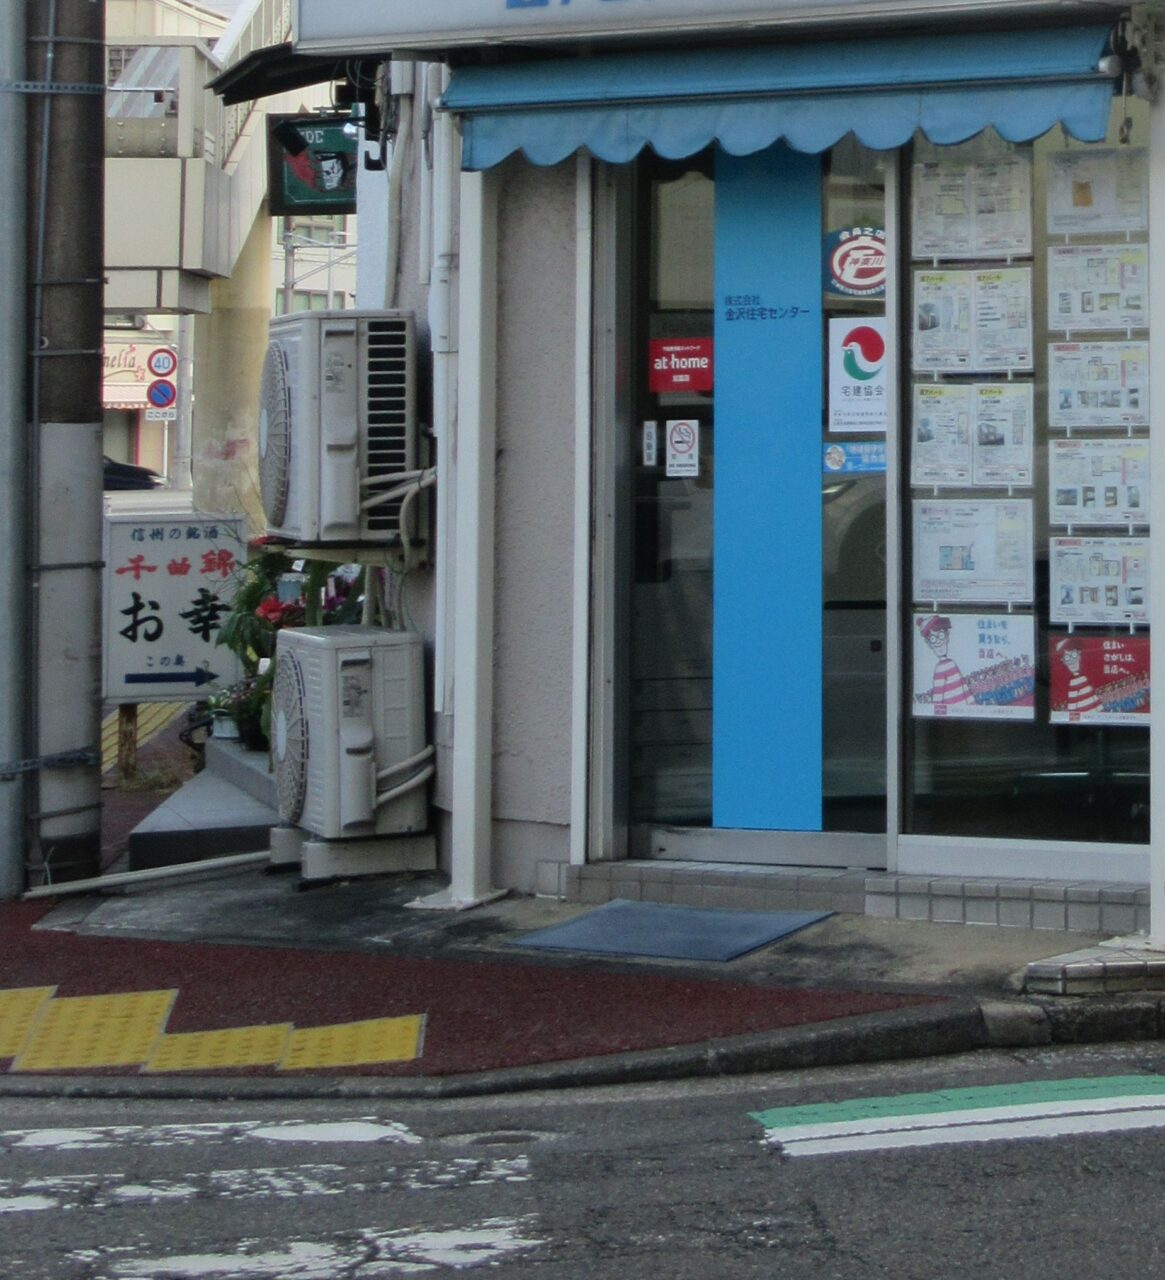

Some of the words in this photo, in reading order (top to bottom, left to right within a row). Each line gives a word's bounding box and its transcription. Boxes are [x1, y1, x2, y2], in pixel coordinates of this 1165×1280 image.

[725, 295, 760, 306] 株式会社
[725, 306, 810, 321] 金沢住宅センター
[154, 357, 170, 369] 40
[654, 357, 668, 370] at
[671, 353, 709, 369] home
[841, 385, 884, 397] 宅建協会
[131, 526, 219, 542] 信州の銘酒
[115, 549, 236, 581] 千曲錦
[119, 587, 232, 643] お幸
